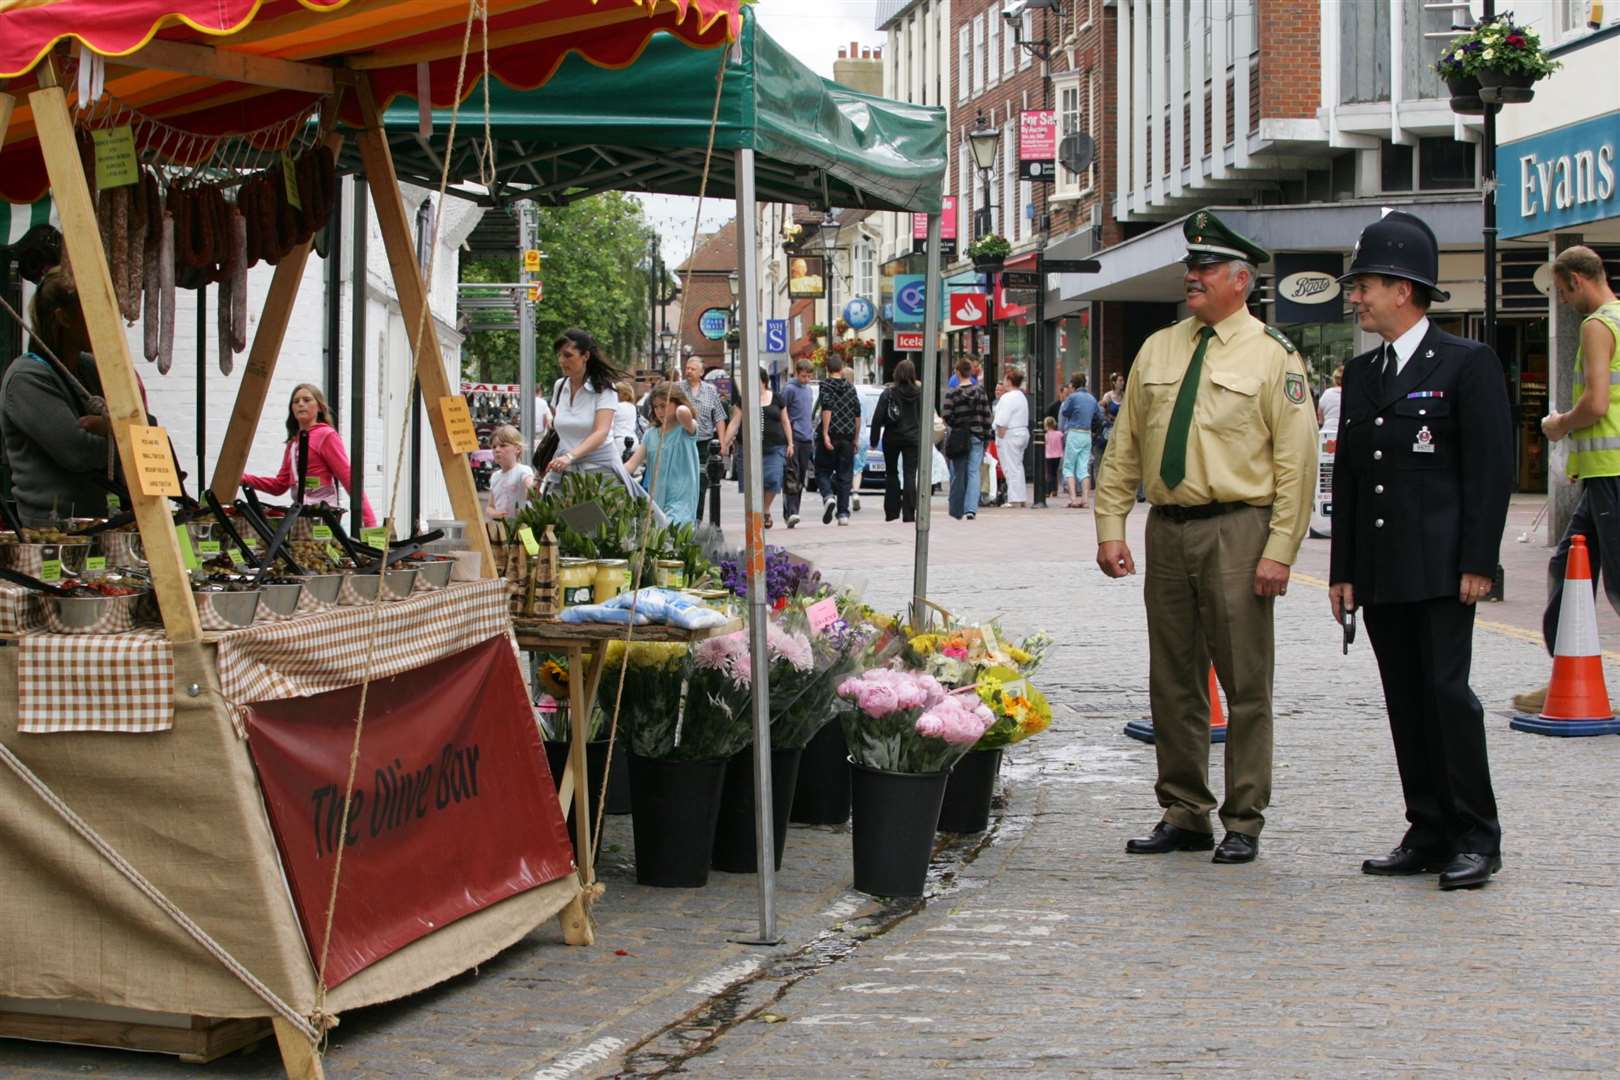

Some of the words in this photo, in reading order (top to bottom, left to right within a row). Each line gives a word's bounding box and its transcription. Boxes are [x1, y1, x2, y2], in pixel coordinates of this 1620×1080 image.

[1021, 112, 1037, 126] For
[1520, 144, 1614, 217] Evans
[1292, 277, 1330, 297] Boots
[769, 329, 784, 351] S
[900, 335, 923, 347] Icela
[460, 383, 520, 392] SALE
[311, 783, 365, 859] The
[369, 757, 433, 838] Olive
[435, 743, 481, 810] Bar
